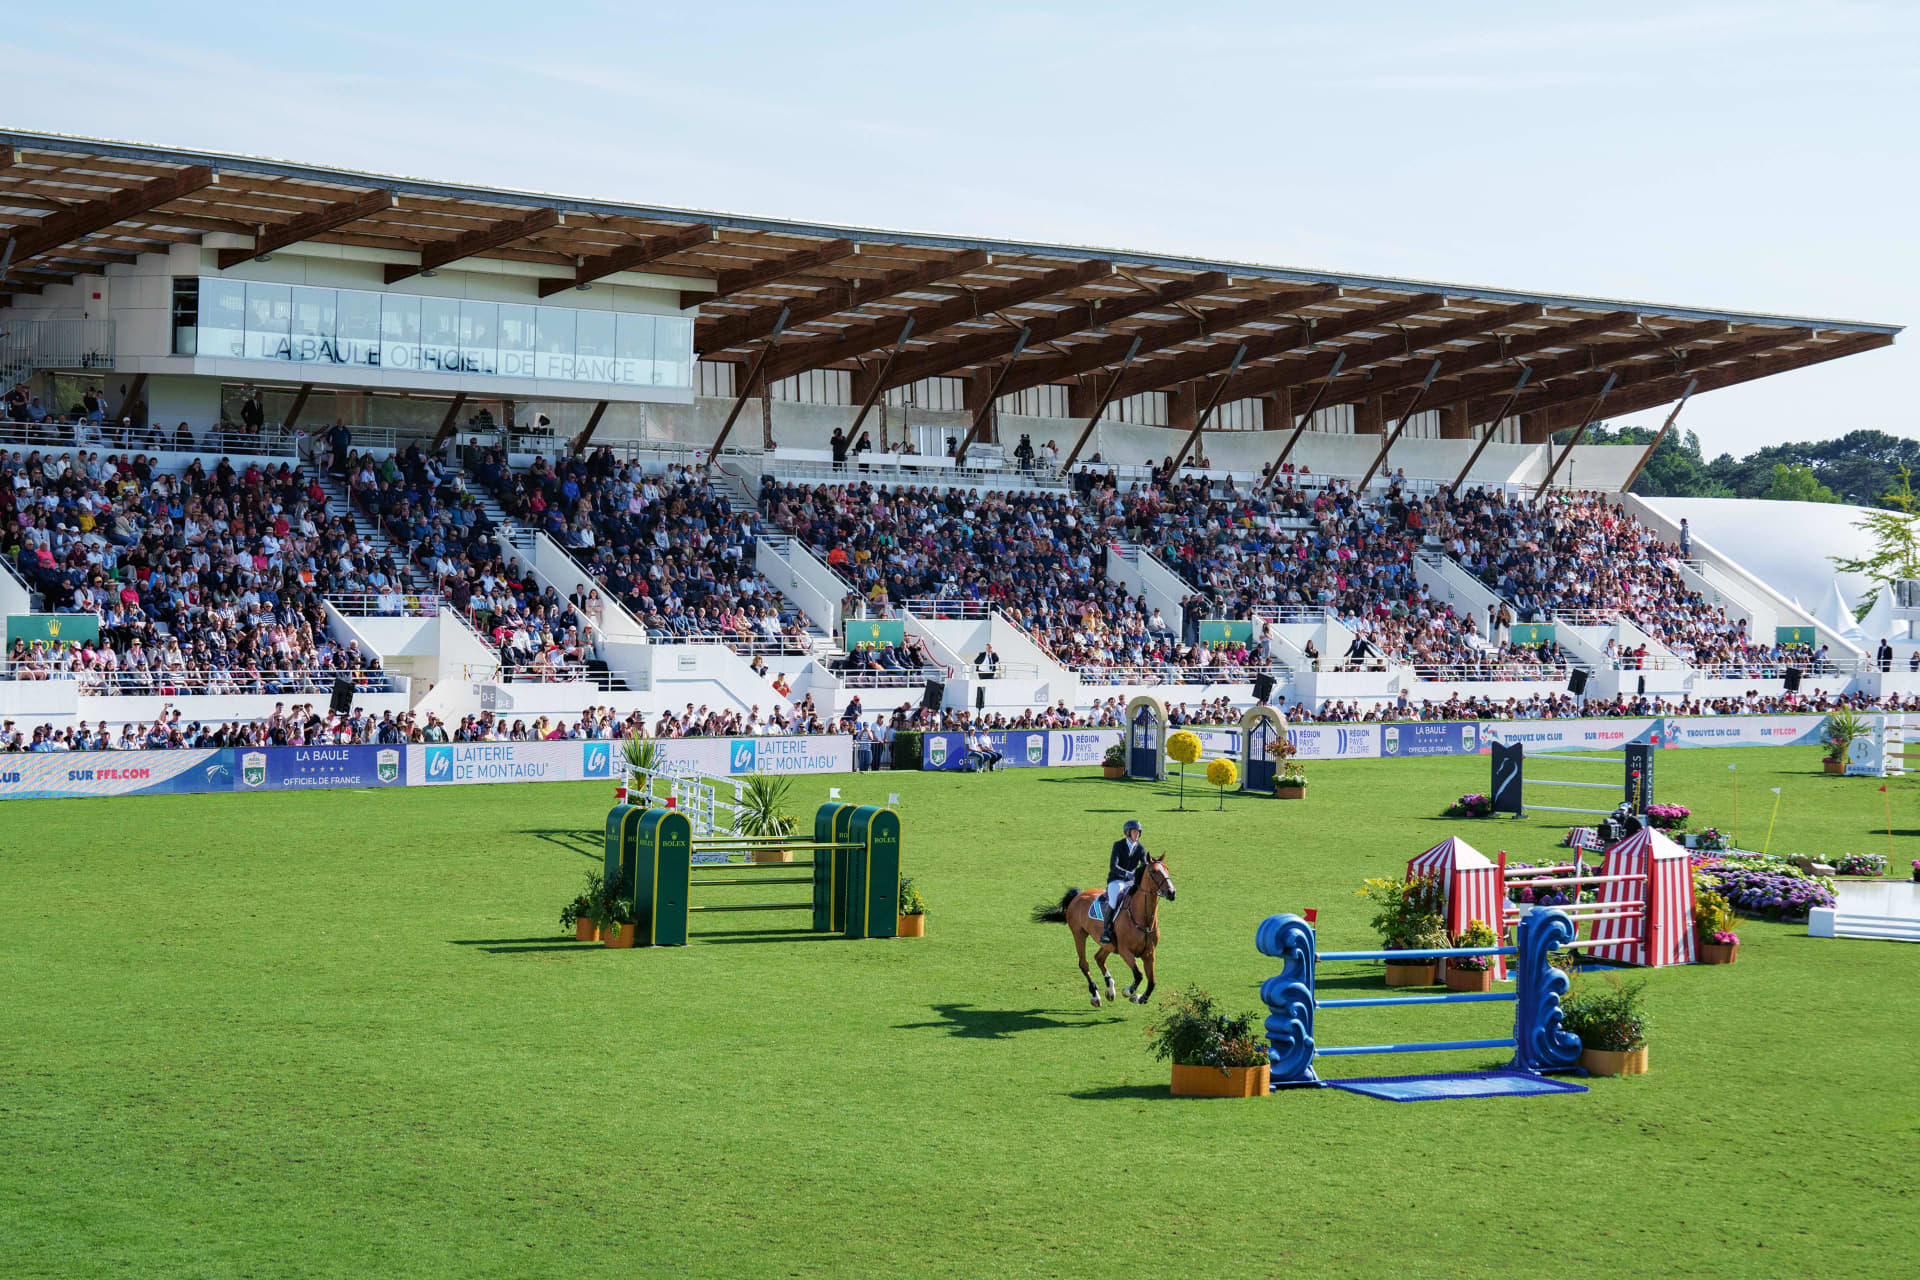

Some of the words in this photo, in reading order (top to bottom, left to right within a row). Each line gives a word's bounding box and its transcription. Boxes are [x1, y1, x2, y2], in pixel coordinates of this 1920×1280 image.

[261, 336, 292, 360] LA
[300, 339, 381, 367] BAULE
[391, 345, 493, 373] OFFICIEL
[504, 353, 536, 376] DE
[549, 357, 635, 382] FRANCE
[1415, 727, 1423, 735] LA
[1425, 726, 1447, 734] BAULE
[1760, 728, 1772, 736] SUR
[1076, 734, 1099, 744] RÉGION
[1504, 733, 1534, 742] TROUVEZ
[1535, 733, 1545, 741] UN
[1585, 732, 1597, 740] SUR
[1598, 731, 1624, 740] FFE.COM
[758, 741, 807, 756] LAITERIE
[1076, 744, 1092, 752] PAYS
[296, 751, 311, 761] LA
[313, 750, 350, 761] BAULE
[456, 747, 514, 762] LAITERIE
[757, 758, 773, 771] DE
[68, 771, 94, 781] SUR
[97, 769, 149, 780] FFE.COM
[456, 765, 473, 779] DE
[284, 777, 318, 786] OFFICIEL
[319, 777, 329, 785] DE
[331, 776, 361, 785] FRANCE
